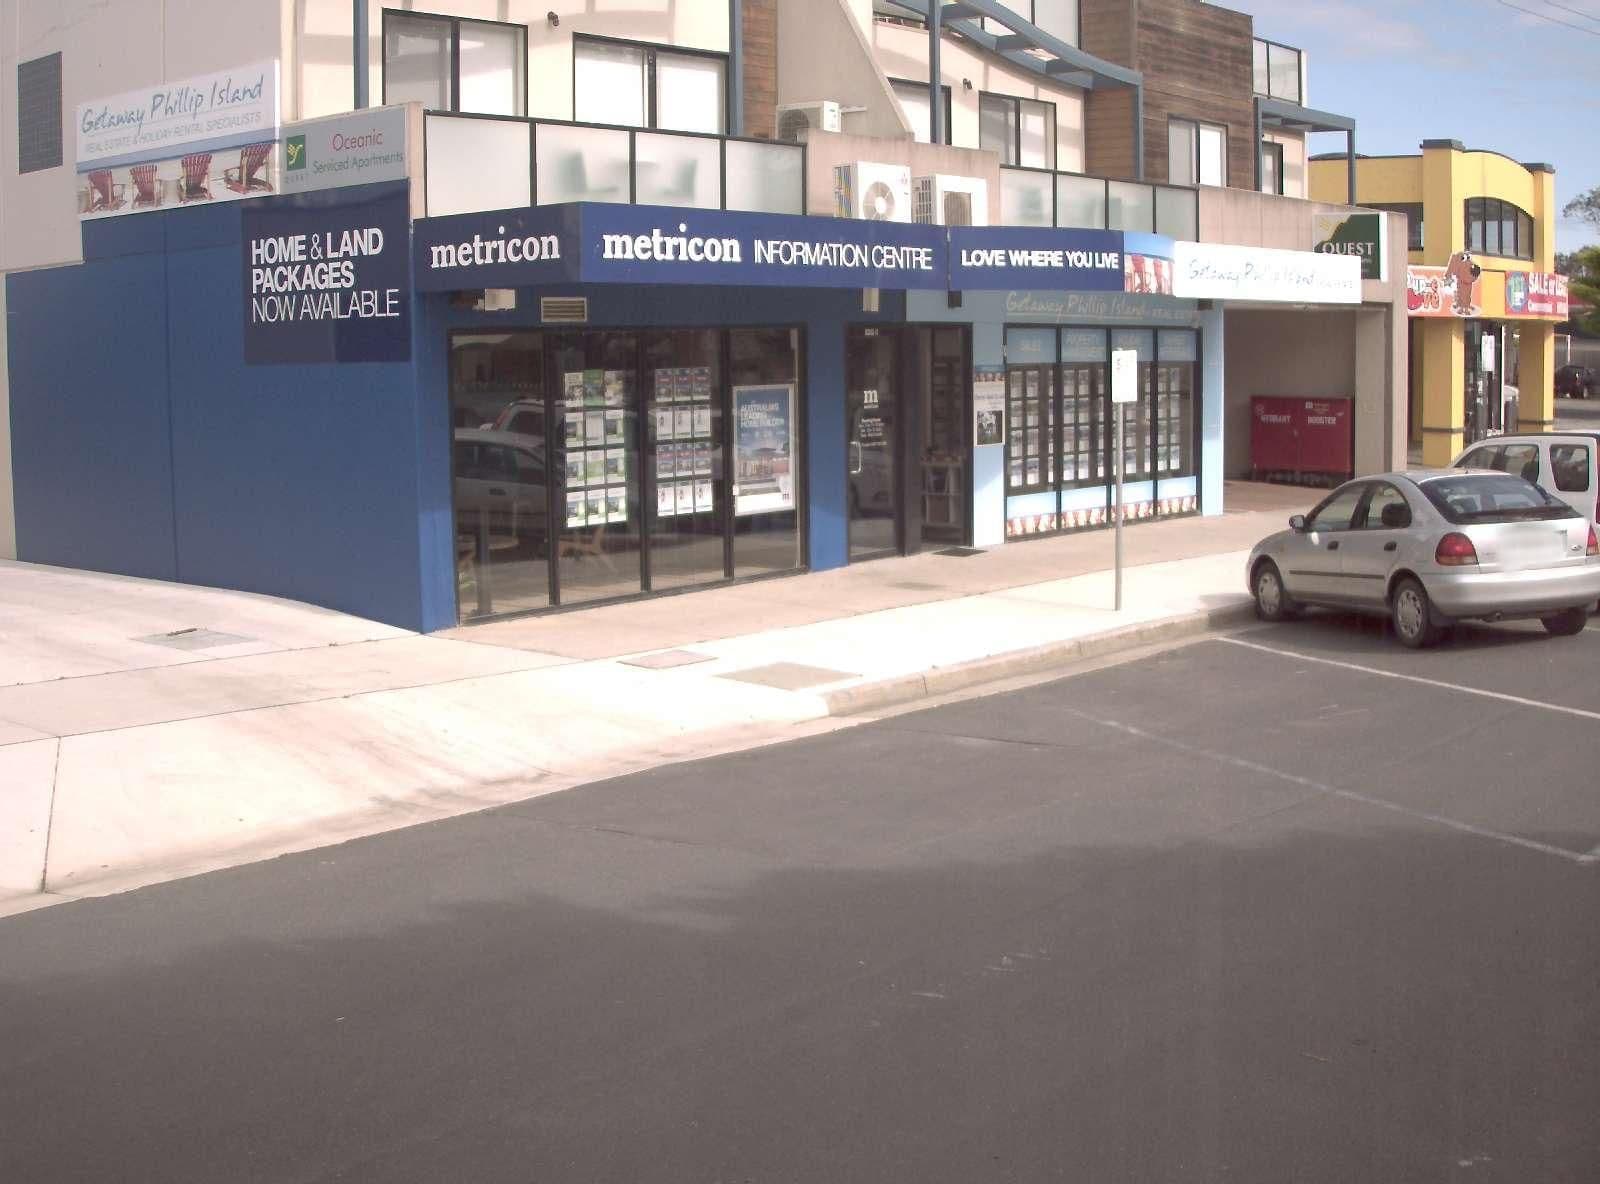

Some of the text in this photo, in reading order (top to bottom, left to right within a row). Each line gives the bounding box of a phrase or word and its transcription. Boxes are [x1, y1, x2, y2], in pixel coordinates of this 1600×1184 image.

[81, 73, 265, 135] Getaway Phillip Island
[206, 111, 263, 132] SPECIALISTS
[332, 128, 384, 152] Oceanic
[312, 149, 405, 174] Serviced Apartments
[252, 227, 384, 265] HOME & LAND
[431, 225, 560, 269] metricon
[602, 223, 933, 270] metricon INFORMATION CENTRE
[961, 249, 1119, 269] LOVE WHERE YOU LIVE
[1322, 242, 1375, 256] QUEST
[252, 260, 355, 294] PACKAGES
[1188, 257, 1242, 289] Getaway
[252, 288, 400, 323] NOW AVAILABLE
[1006, 291, 1063, 322] Getaway
[1067, 293, 1107, 321] Phillip
[1110, 295, 1146, 317] Island
[863, 389, 879, 404] m
